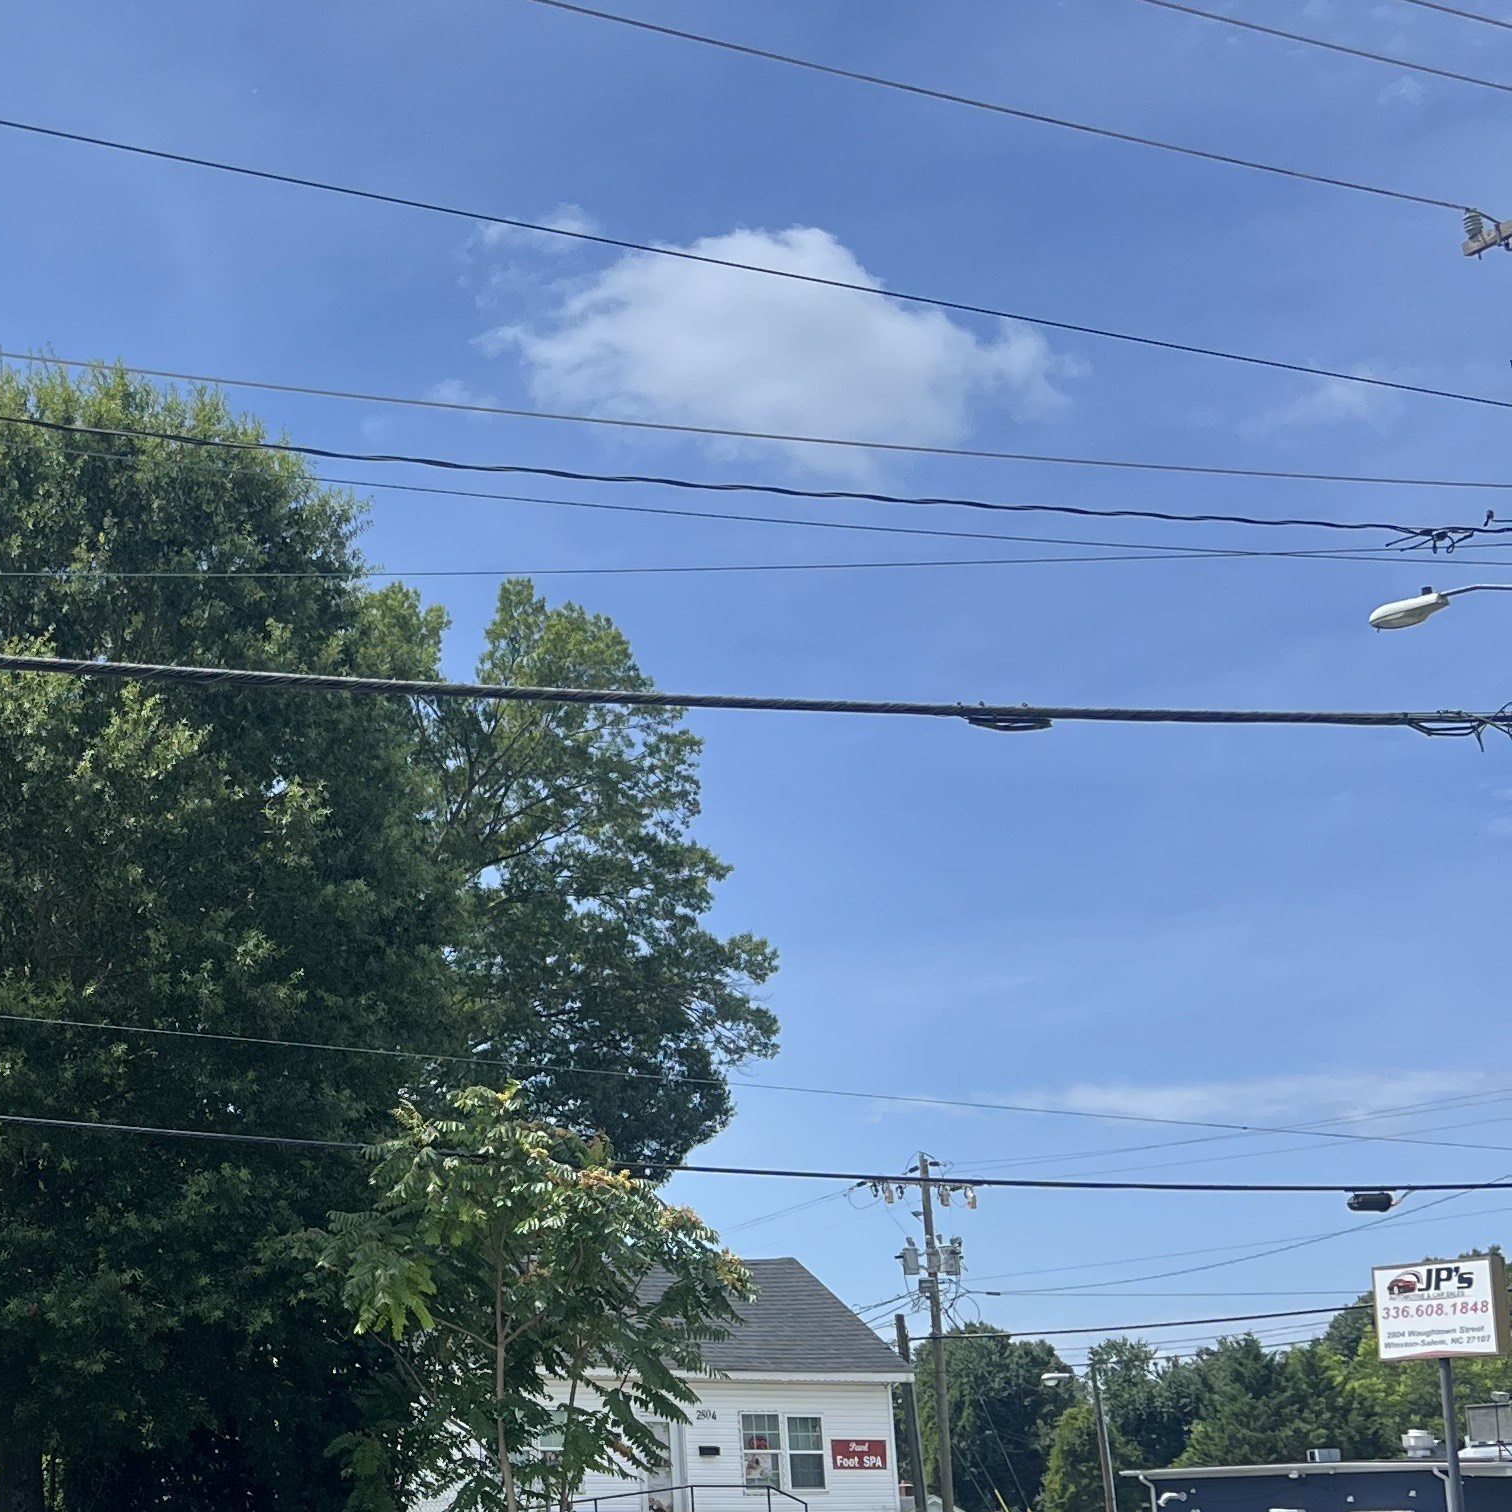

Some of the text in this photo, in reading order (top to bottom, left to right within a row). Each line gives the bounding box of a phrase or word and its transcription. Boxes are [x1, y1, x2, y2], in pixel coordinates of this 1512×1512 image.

[1418, 1266, 1474, 1292] JP's
[1382, 1300, 1489, 1320] 336.608.1848
[1459, 1325, 1485, 1334] Street
[1451, 1336, 1464, 1344] NC
[836, 1455, 883, 1468] Foot SPA
